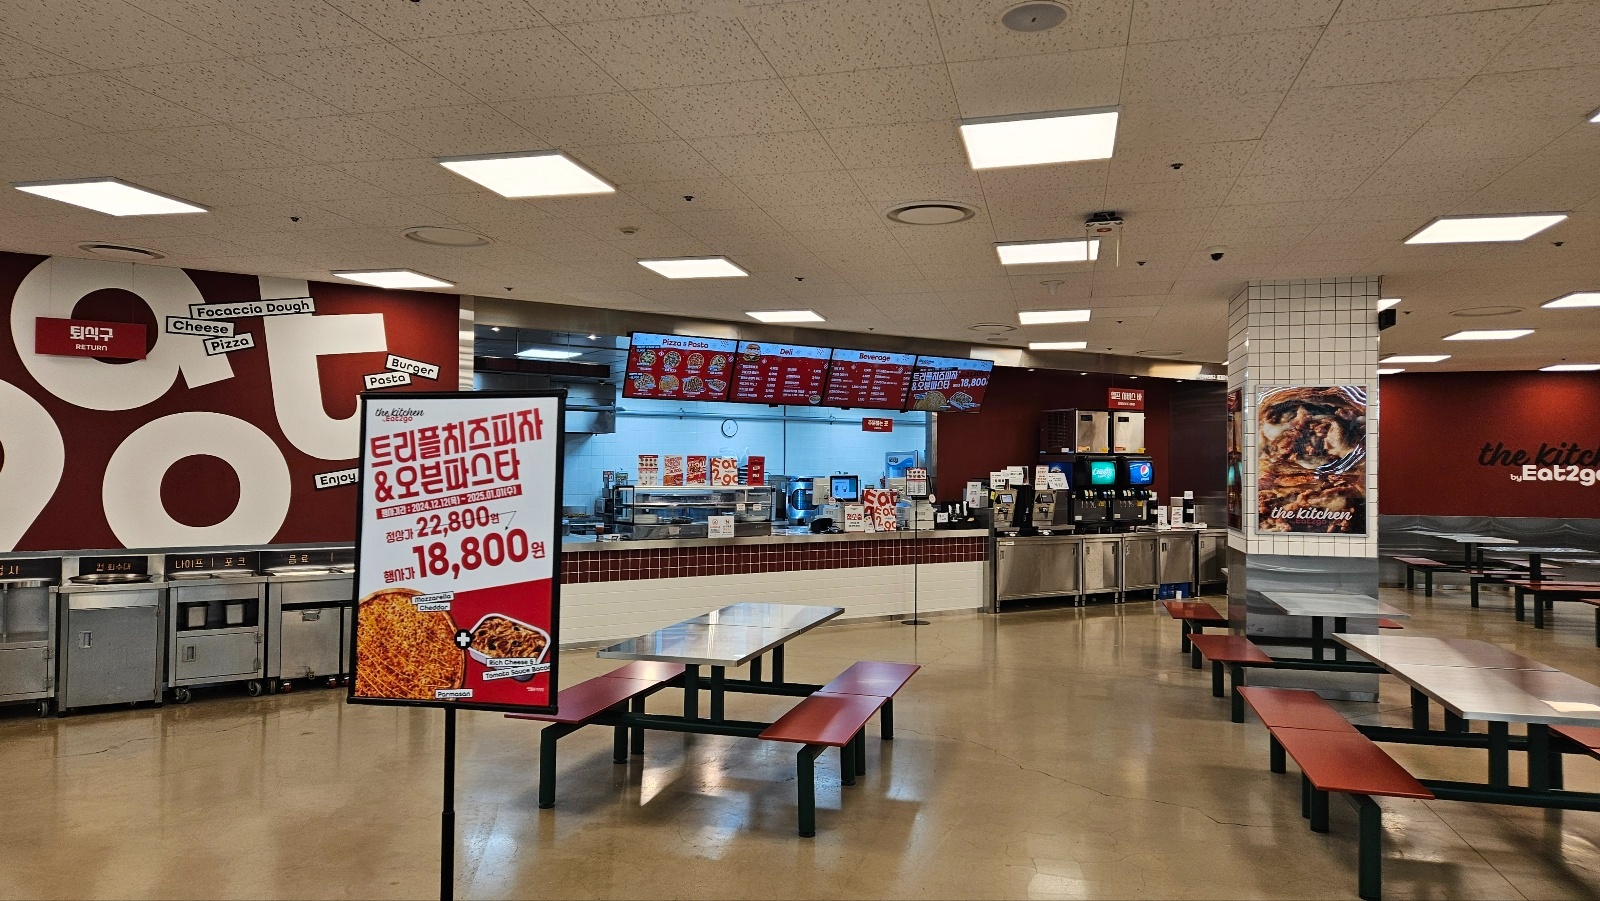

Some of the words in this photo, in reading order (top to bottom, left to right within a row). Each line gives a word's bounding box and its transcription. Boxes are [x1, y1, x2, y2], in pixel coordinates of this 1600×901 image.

[197, 304, 262, 318] Focaccia
[266, 300, 310, 313] Dough
[70, 326, 114, 342] 퇴식구
[173, 320, 228, 334] Cheese
[211, 338, 249, 351] Pizza
[859, 353, 890, 362] Beverage
[392, 358, 434, 376] Burger
[370, 374, 406, 386] Pasta
[375, 408, 389, 416] the
[391, 408, 424, 416] kitchen
[370, 408, 543, 468] 트리플치즈피자
[1478, 442, 1530, 466] the
[320, 472, 356, 486] Enjoy
[374, 448, 520, 502] &오븐파스타
[1510, 474, 1522, 482] by
[1522, 464, 1600, 486] Eat2g
[411, 496, 460, 512] 2024.12.12(목)
[467, 486, 517, 501] 2025.01.01(수)
[1271, 506, 1295, 519] the
[1296, 507, 1352, 520] kitchen
[386, 528, 414, 543] 정상가
[176, 559, 203, 568] 나이프
[384, 566, 415, 584] 행사가
[415, 594, 451, 602] Mozzarella
